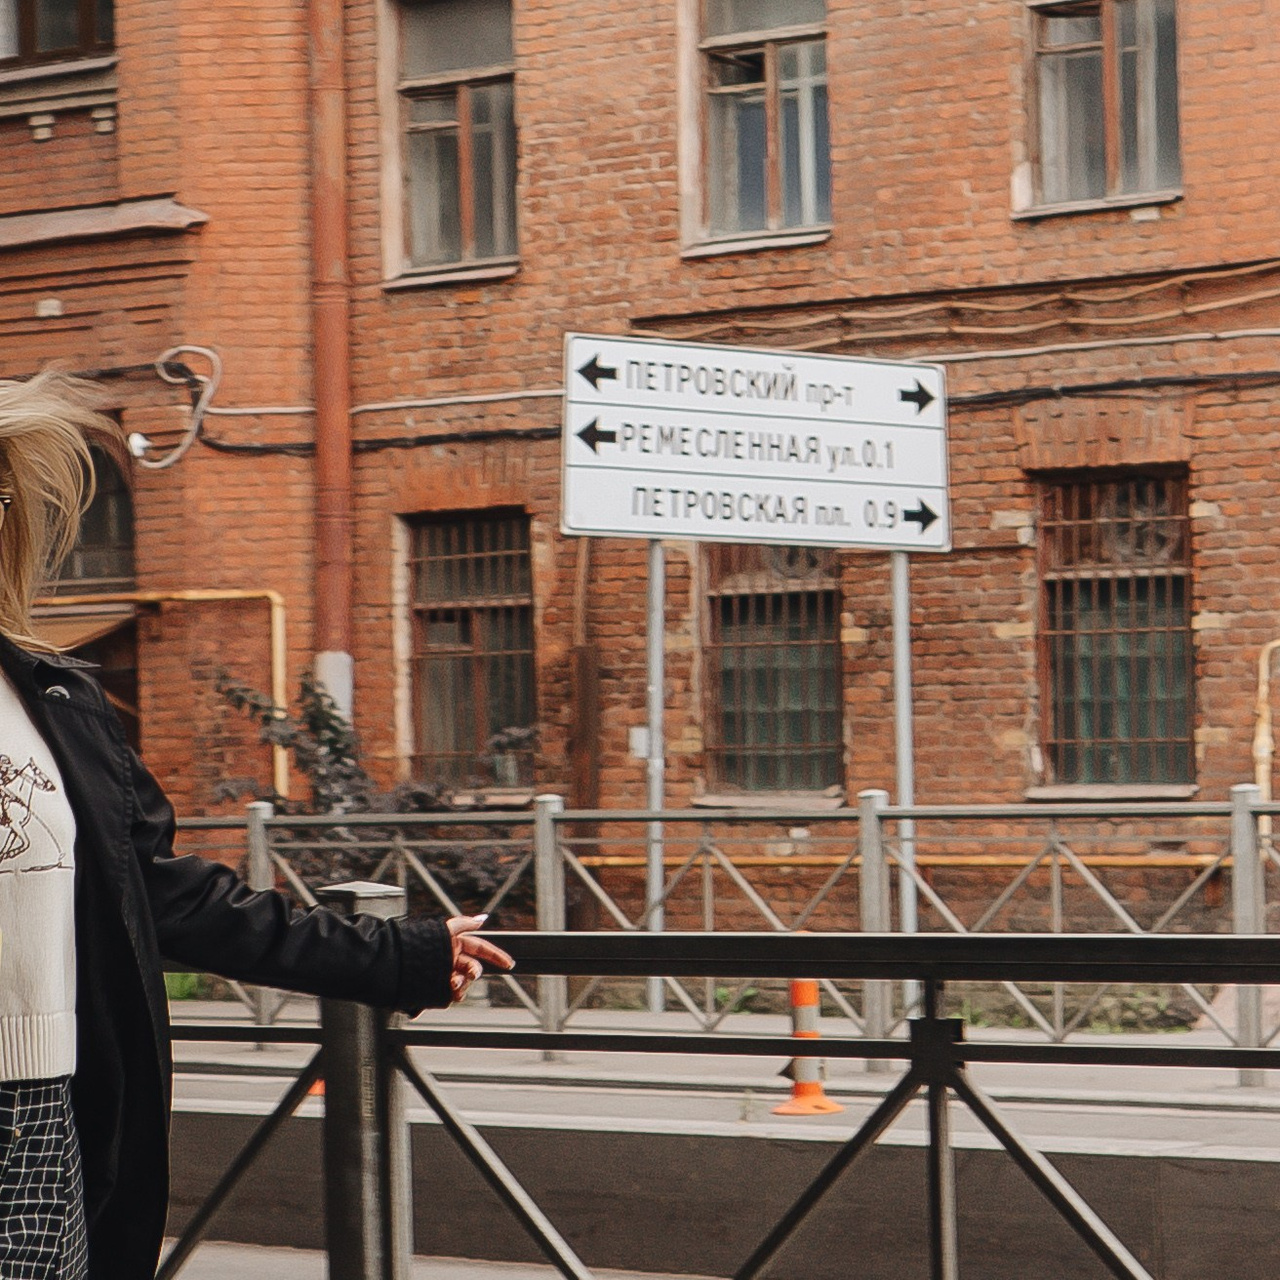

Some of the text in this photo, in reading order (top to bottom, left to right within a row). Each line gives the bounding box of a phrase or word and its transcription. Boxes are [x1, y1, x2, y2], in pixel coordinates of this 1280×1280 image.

[626, 360, 855, 412] ПЕТРОВСКИЙ пр-т
[620, 423, 821, 465] РЕМЕСЛЕННАЯ
[632, 487, 898, 529] ПЕТРОВСКАЯ пл. 0.9
